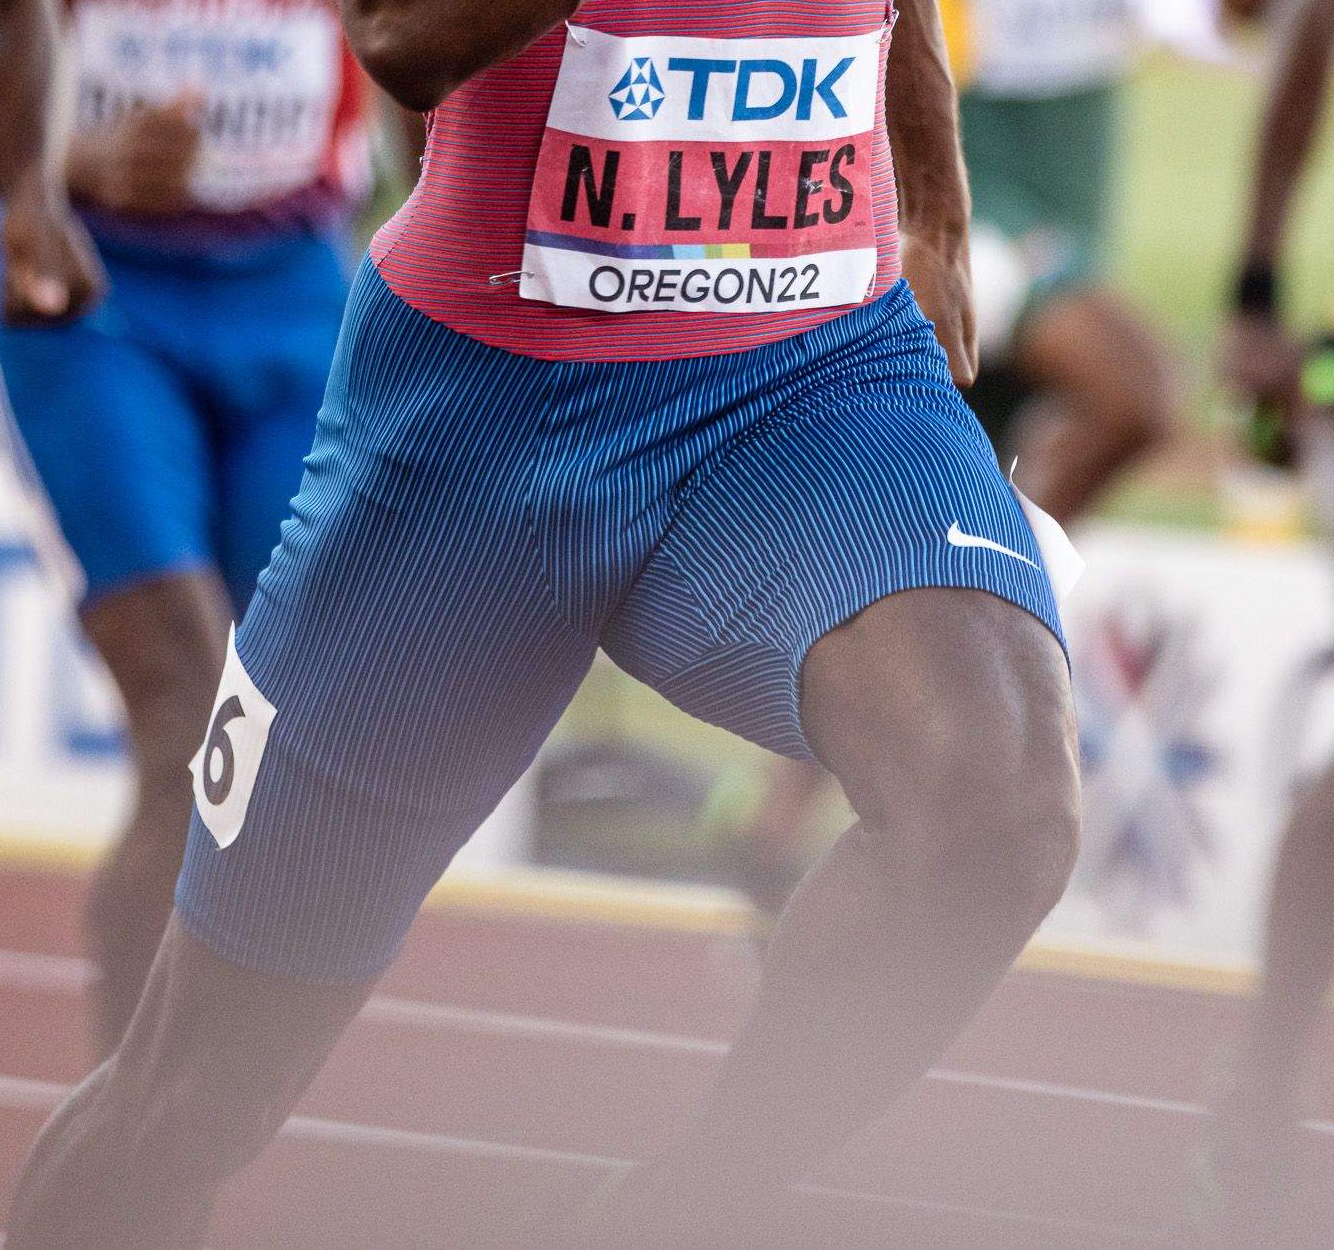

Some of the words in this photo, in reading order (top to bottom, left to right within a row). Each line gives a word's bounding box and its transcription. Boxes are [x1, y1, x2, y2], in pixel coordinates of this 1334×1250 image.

[668, 56, 855, 121] TDK
[560, 143, 636, 229] N.
[664, 143, 854, 231] LYLES
[588, 264, 820, 304] OREGON22
[203, 695, 246, 805] 6
